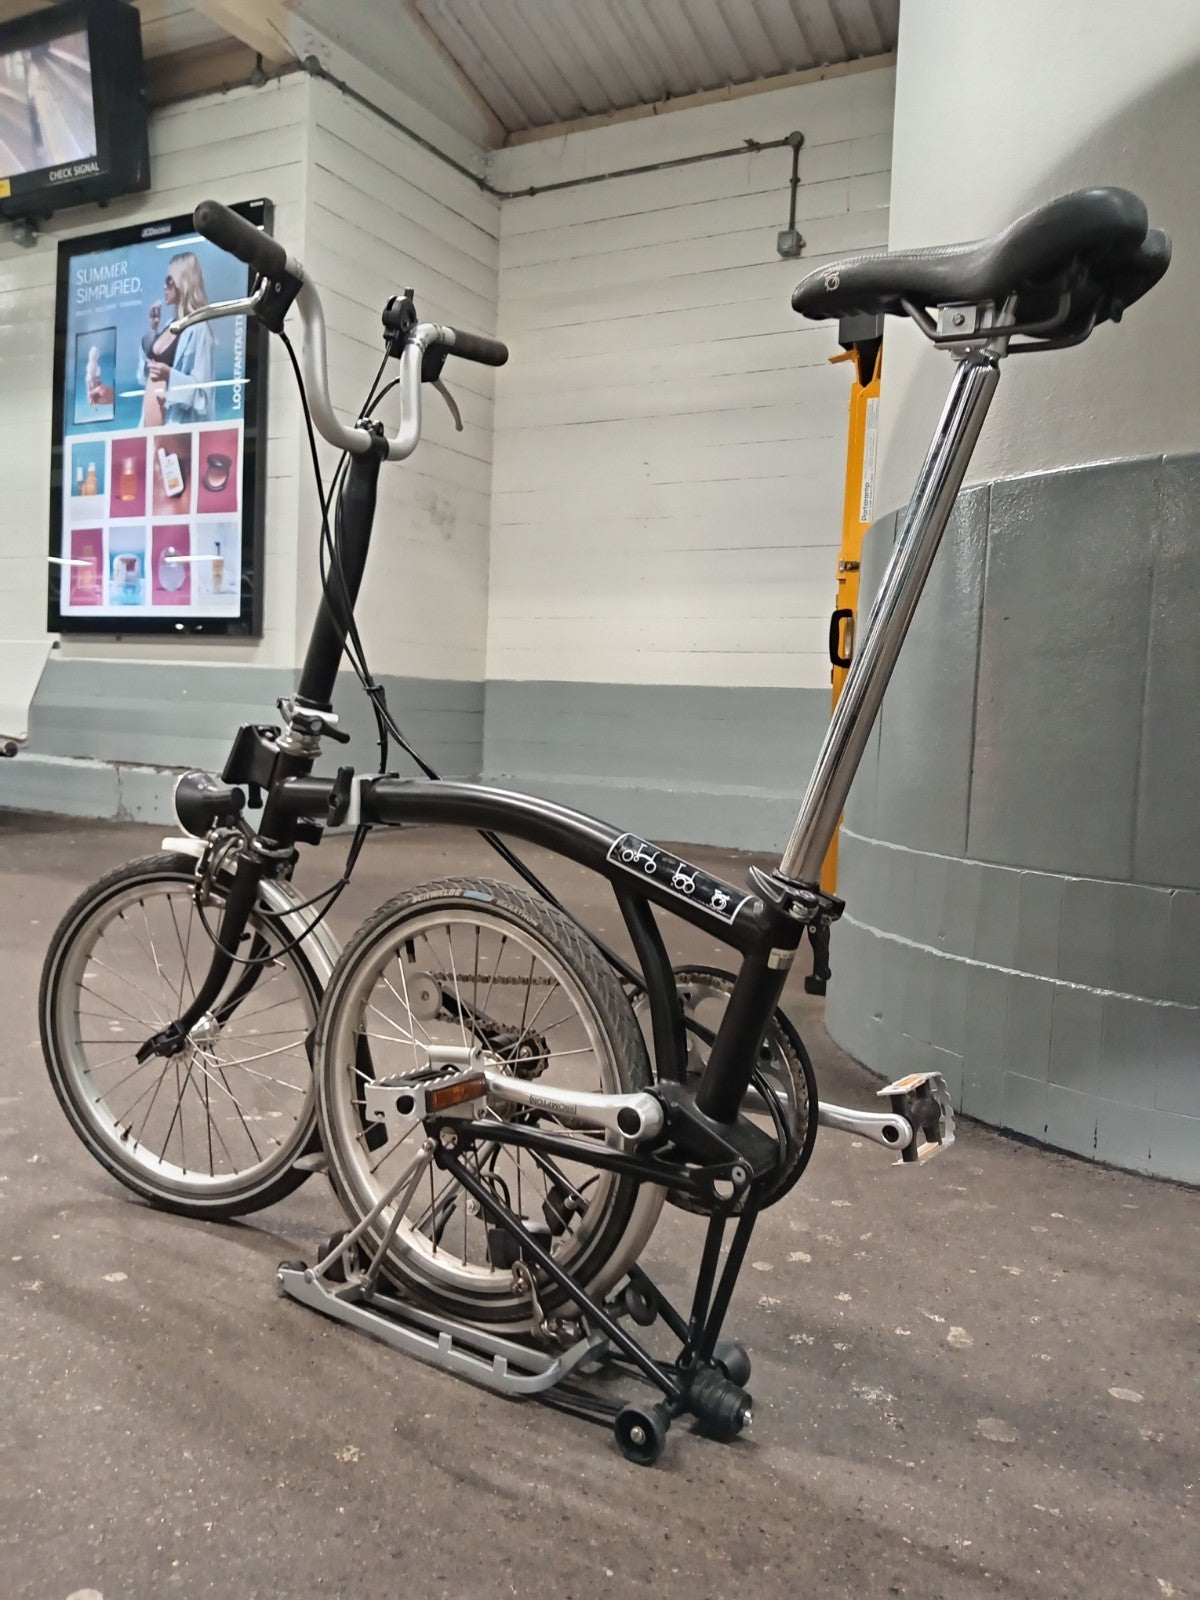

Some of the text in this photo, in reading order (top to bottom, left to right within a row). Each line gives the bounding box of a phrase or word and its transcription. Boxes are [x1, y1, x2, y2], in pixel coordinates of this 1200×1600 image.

[49, 161, 99, 181] CHECK SIGNAL
[77, 260, 128, 285] SUMMER
[77, 277, 143, 304] SIMPLIFIED.
[861, 481, 870, 521] Portaramp
